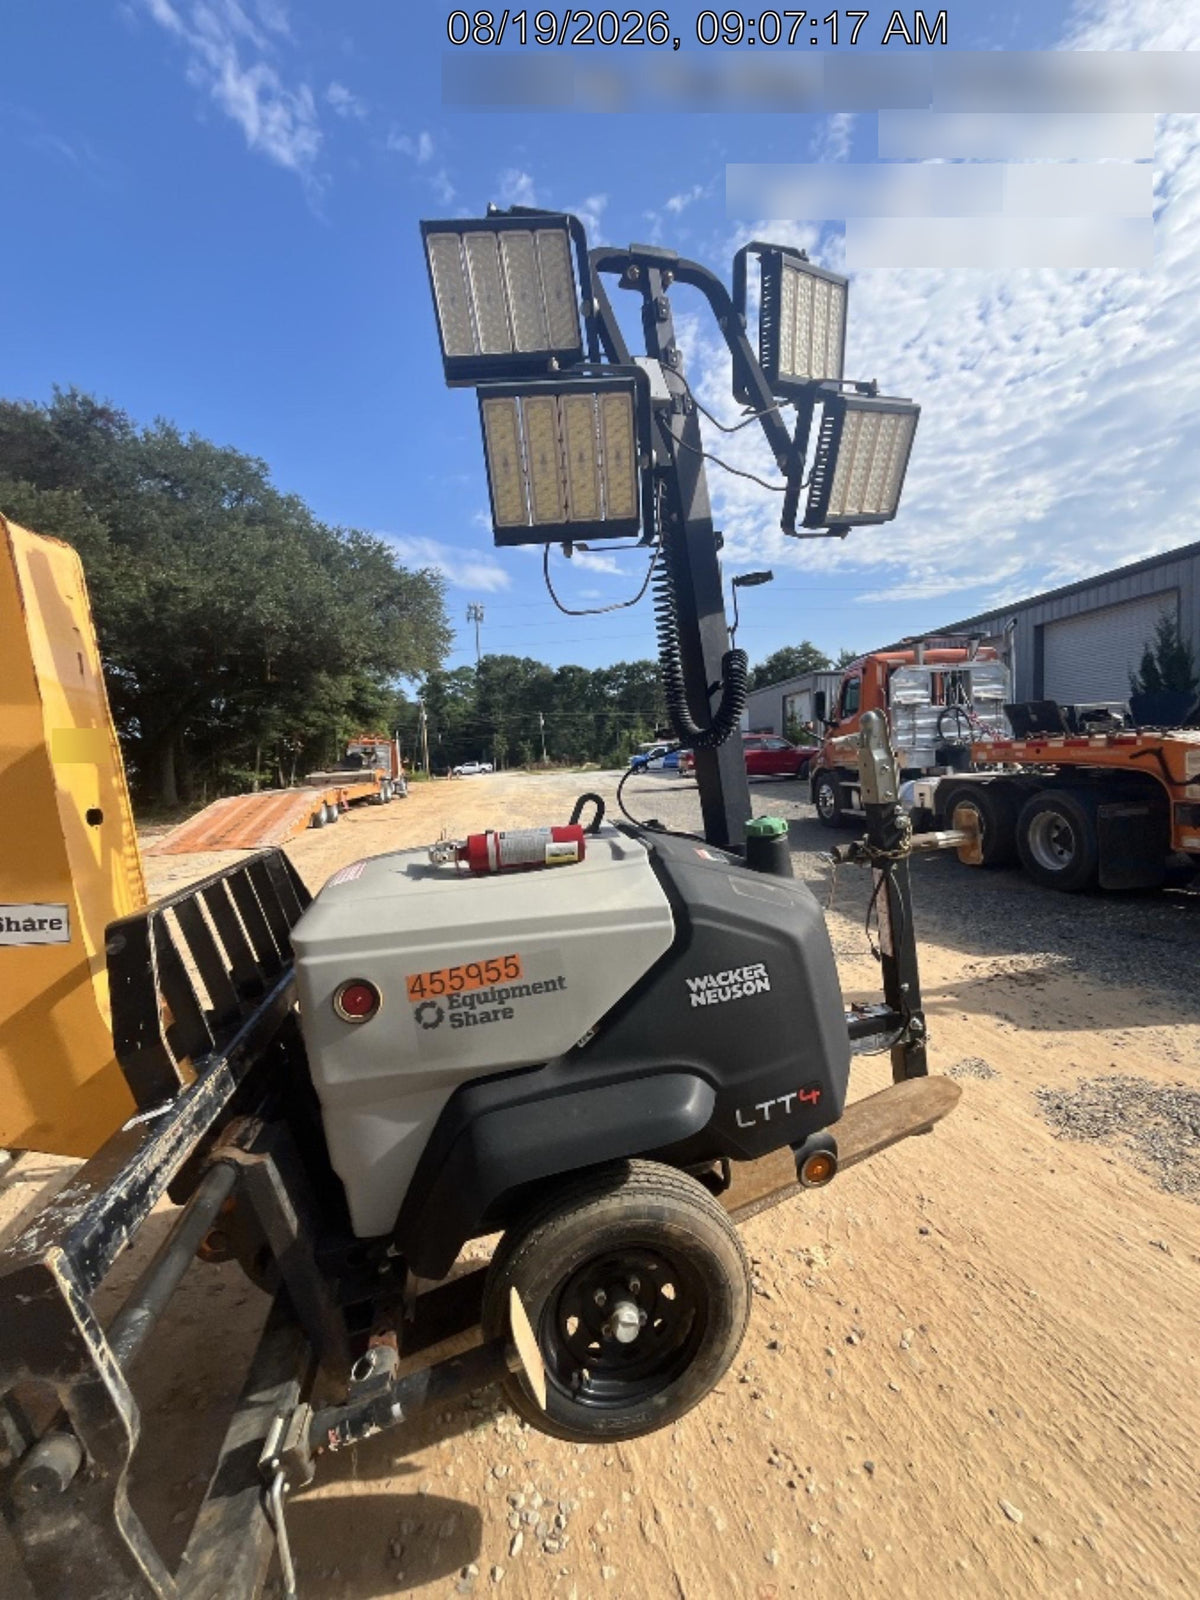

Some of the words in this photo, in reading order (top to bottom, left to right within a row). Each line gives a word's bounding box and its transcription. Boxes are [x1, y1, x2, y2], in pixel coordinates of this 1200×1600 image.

[0, 916, 63, 932] hare
[409, 954, 520, 998] 455955
[685, 962, 769, 992] WACKER
[448, 975, 567, 1010] Equipment
[690, 977, 770, 1007] NEUSON
[450, 1007, 514, 1029] Share
[735, 1088, 821, 1127] LTT4
